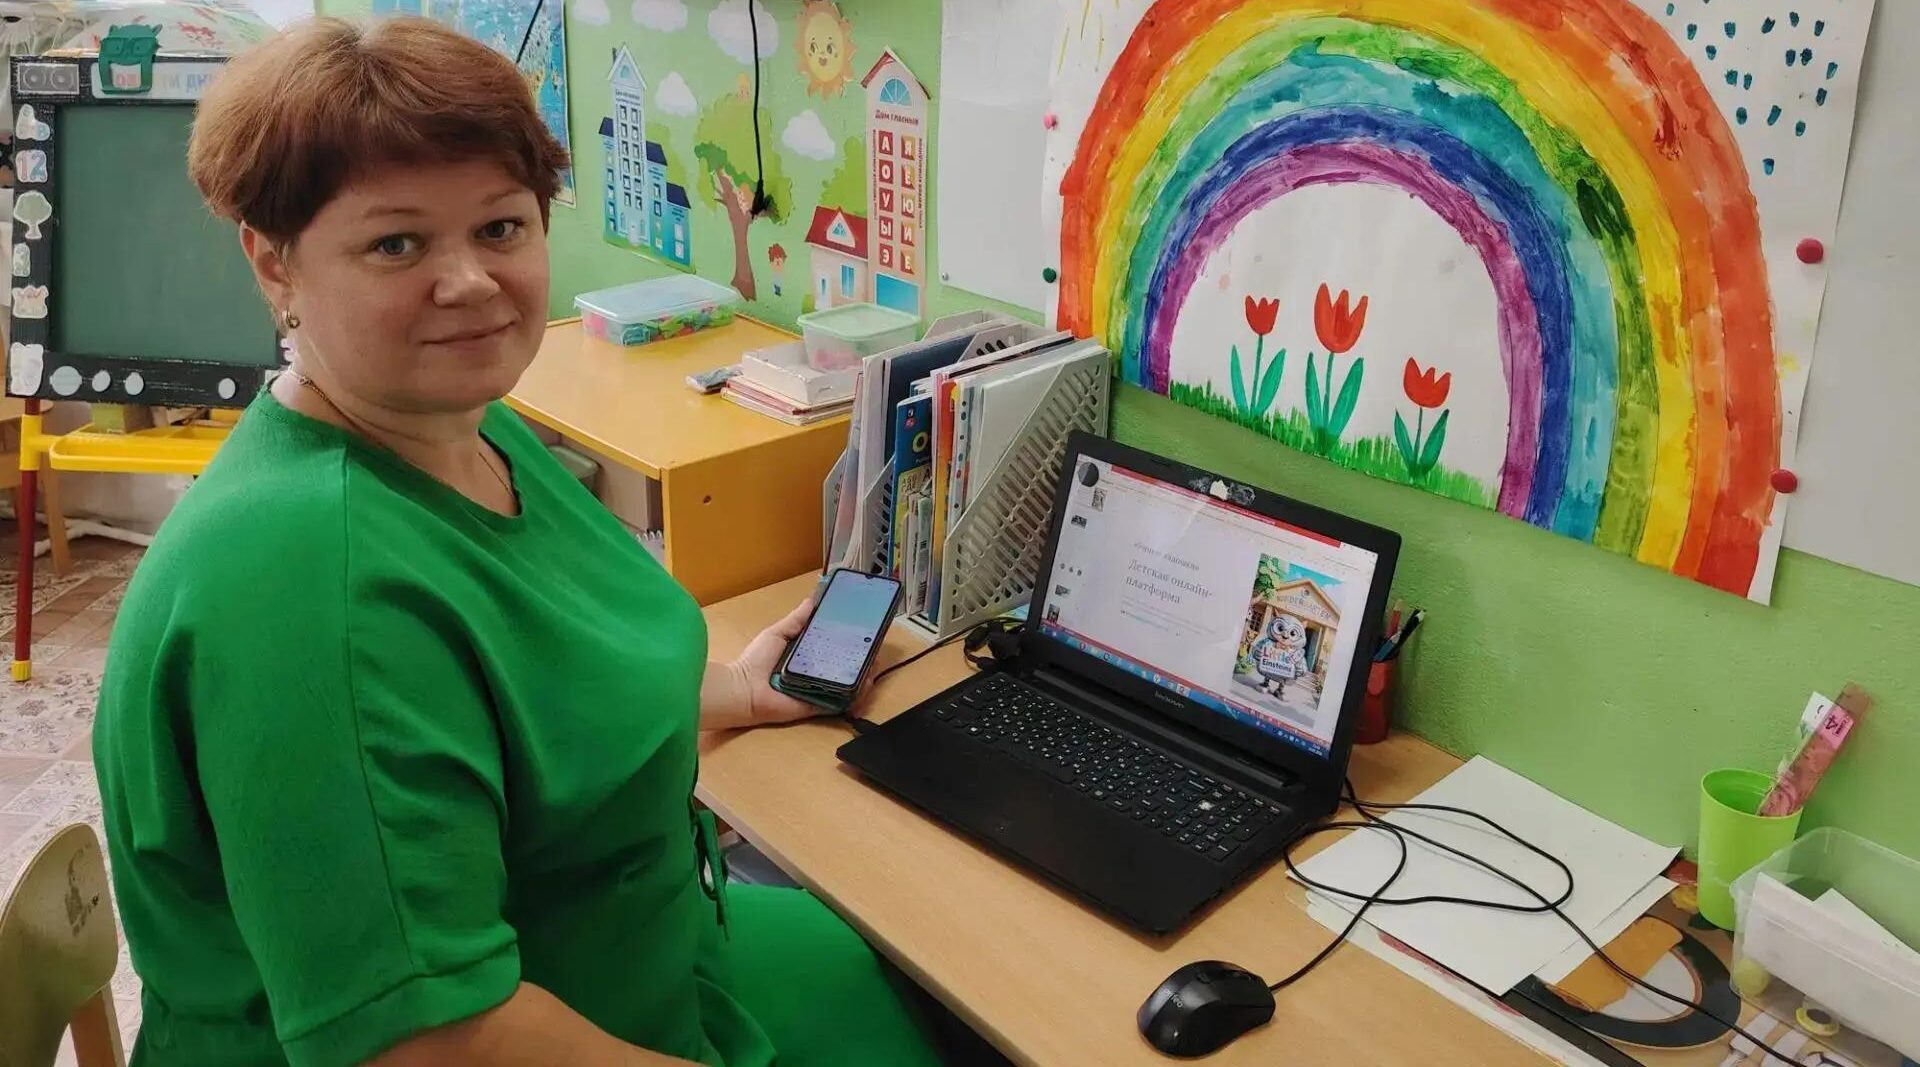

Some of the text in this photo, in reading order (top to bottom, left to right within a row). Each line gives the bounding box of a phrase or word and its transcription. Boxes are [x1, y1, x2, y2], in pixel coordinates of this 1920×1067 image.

[881, 135, 912, 156] А Я
[881, 164, 891, 180] О
[882, 192, 914, 214] У Ю
[881, 220, 912, 242] Ы И
[882, 248, 911, 270] Э Е
[1127, 558, 1169, 582] Детская
[1125, 576, 1181, 604] платформа
